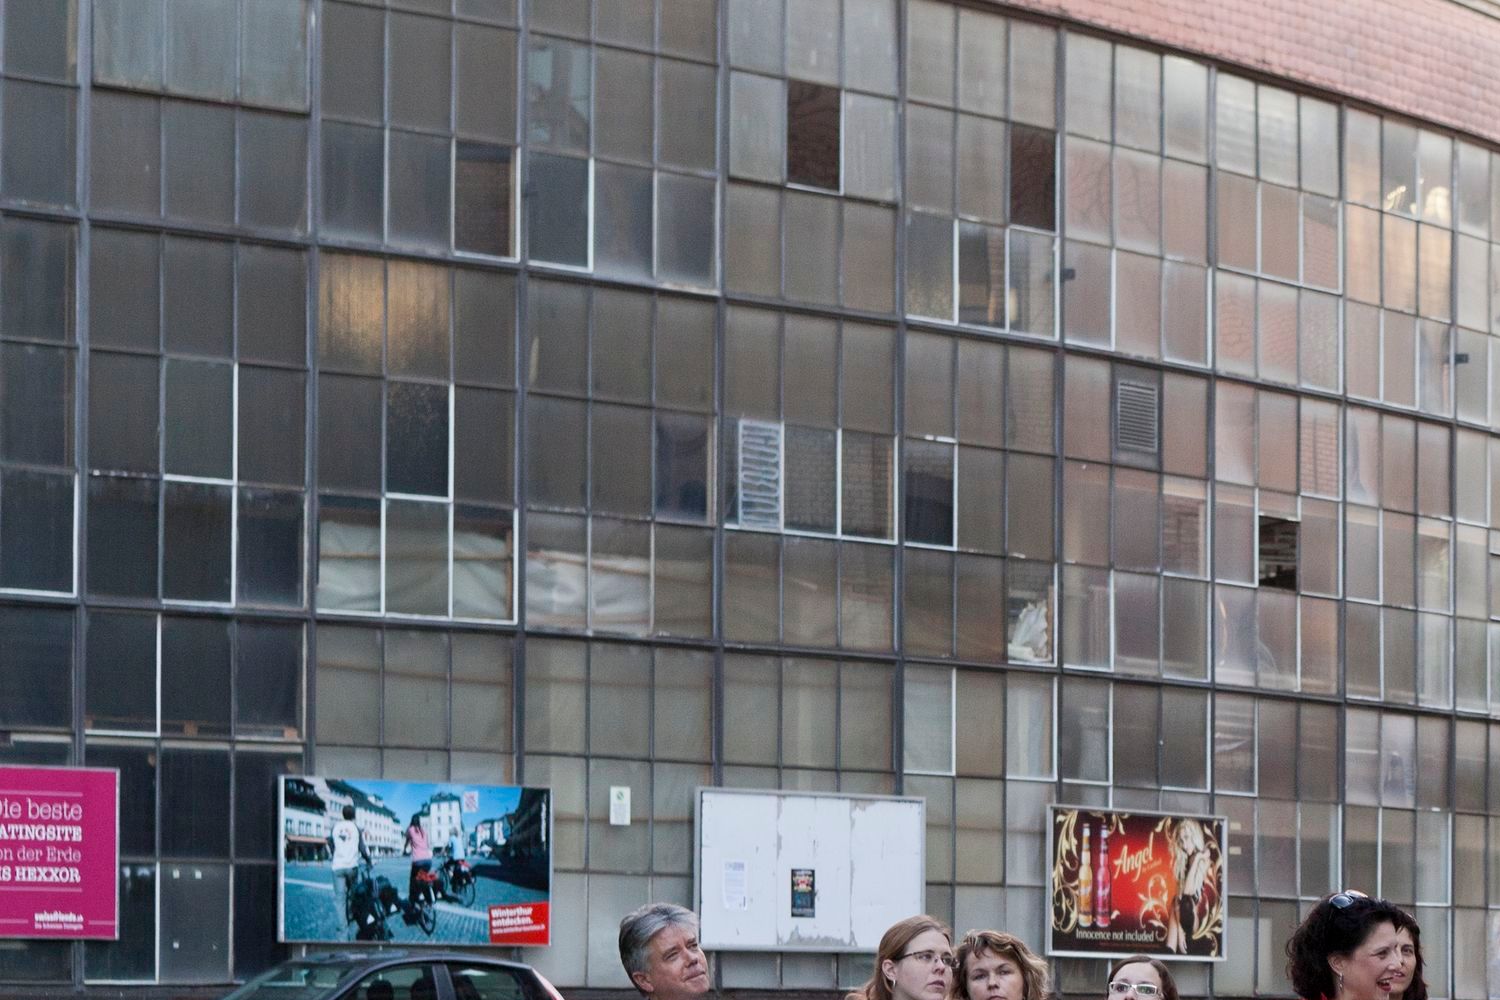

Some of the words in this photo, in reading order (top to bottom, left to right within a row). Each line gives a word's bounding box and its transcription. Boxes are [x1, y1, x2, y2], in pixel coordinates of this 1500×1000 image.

[0, 797, 21, 819] ie
[26, 797, 83, 821] beste
[17, 845, 43, 862] der
[46, 845, 82, 863] Erde
[1113, 831, 1154, 882] Angel
[15, 866, 81, 883] HEXXOR
[491, 906, 533, 918] Winterthur
[1076, 928, 1111, 939] Innocence
[1112, 931, 1124, 941] not
[1125, 930, 1154, 942] included
